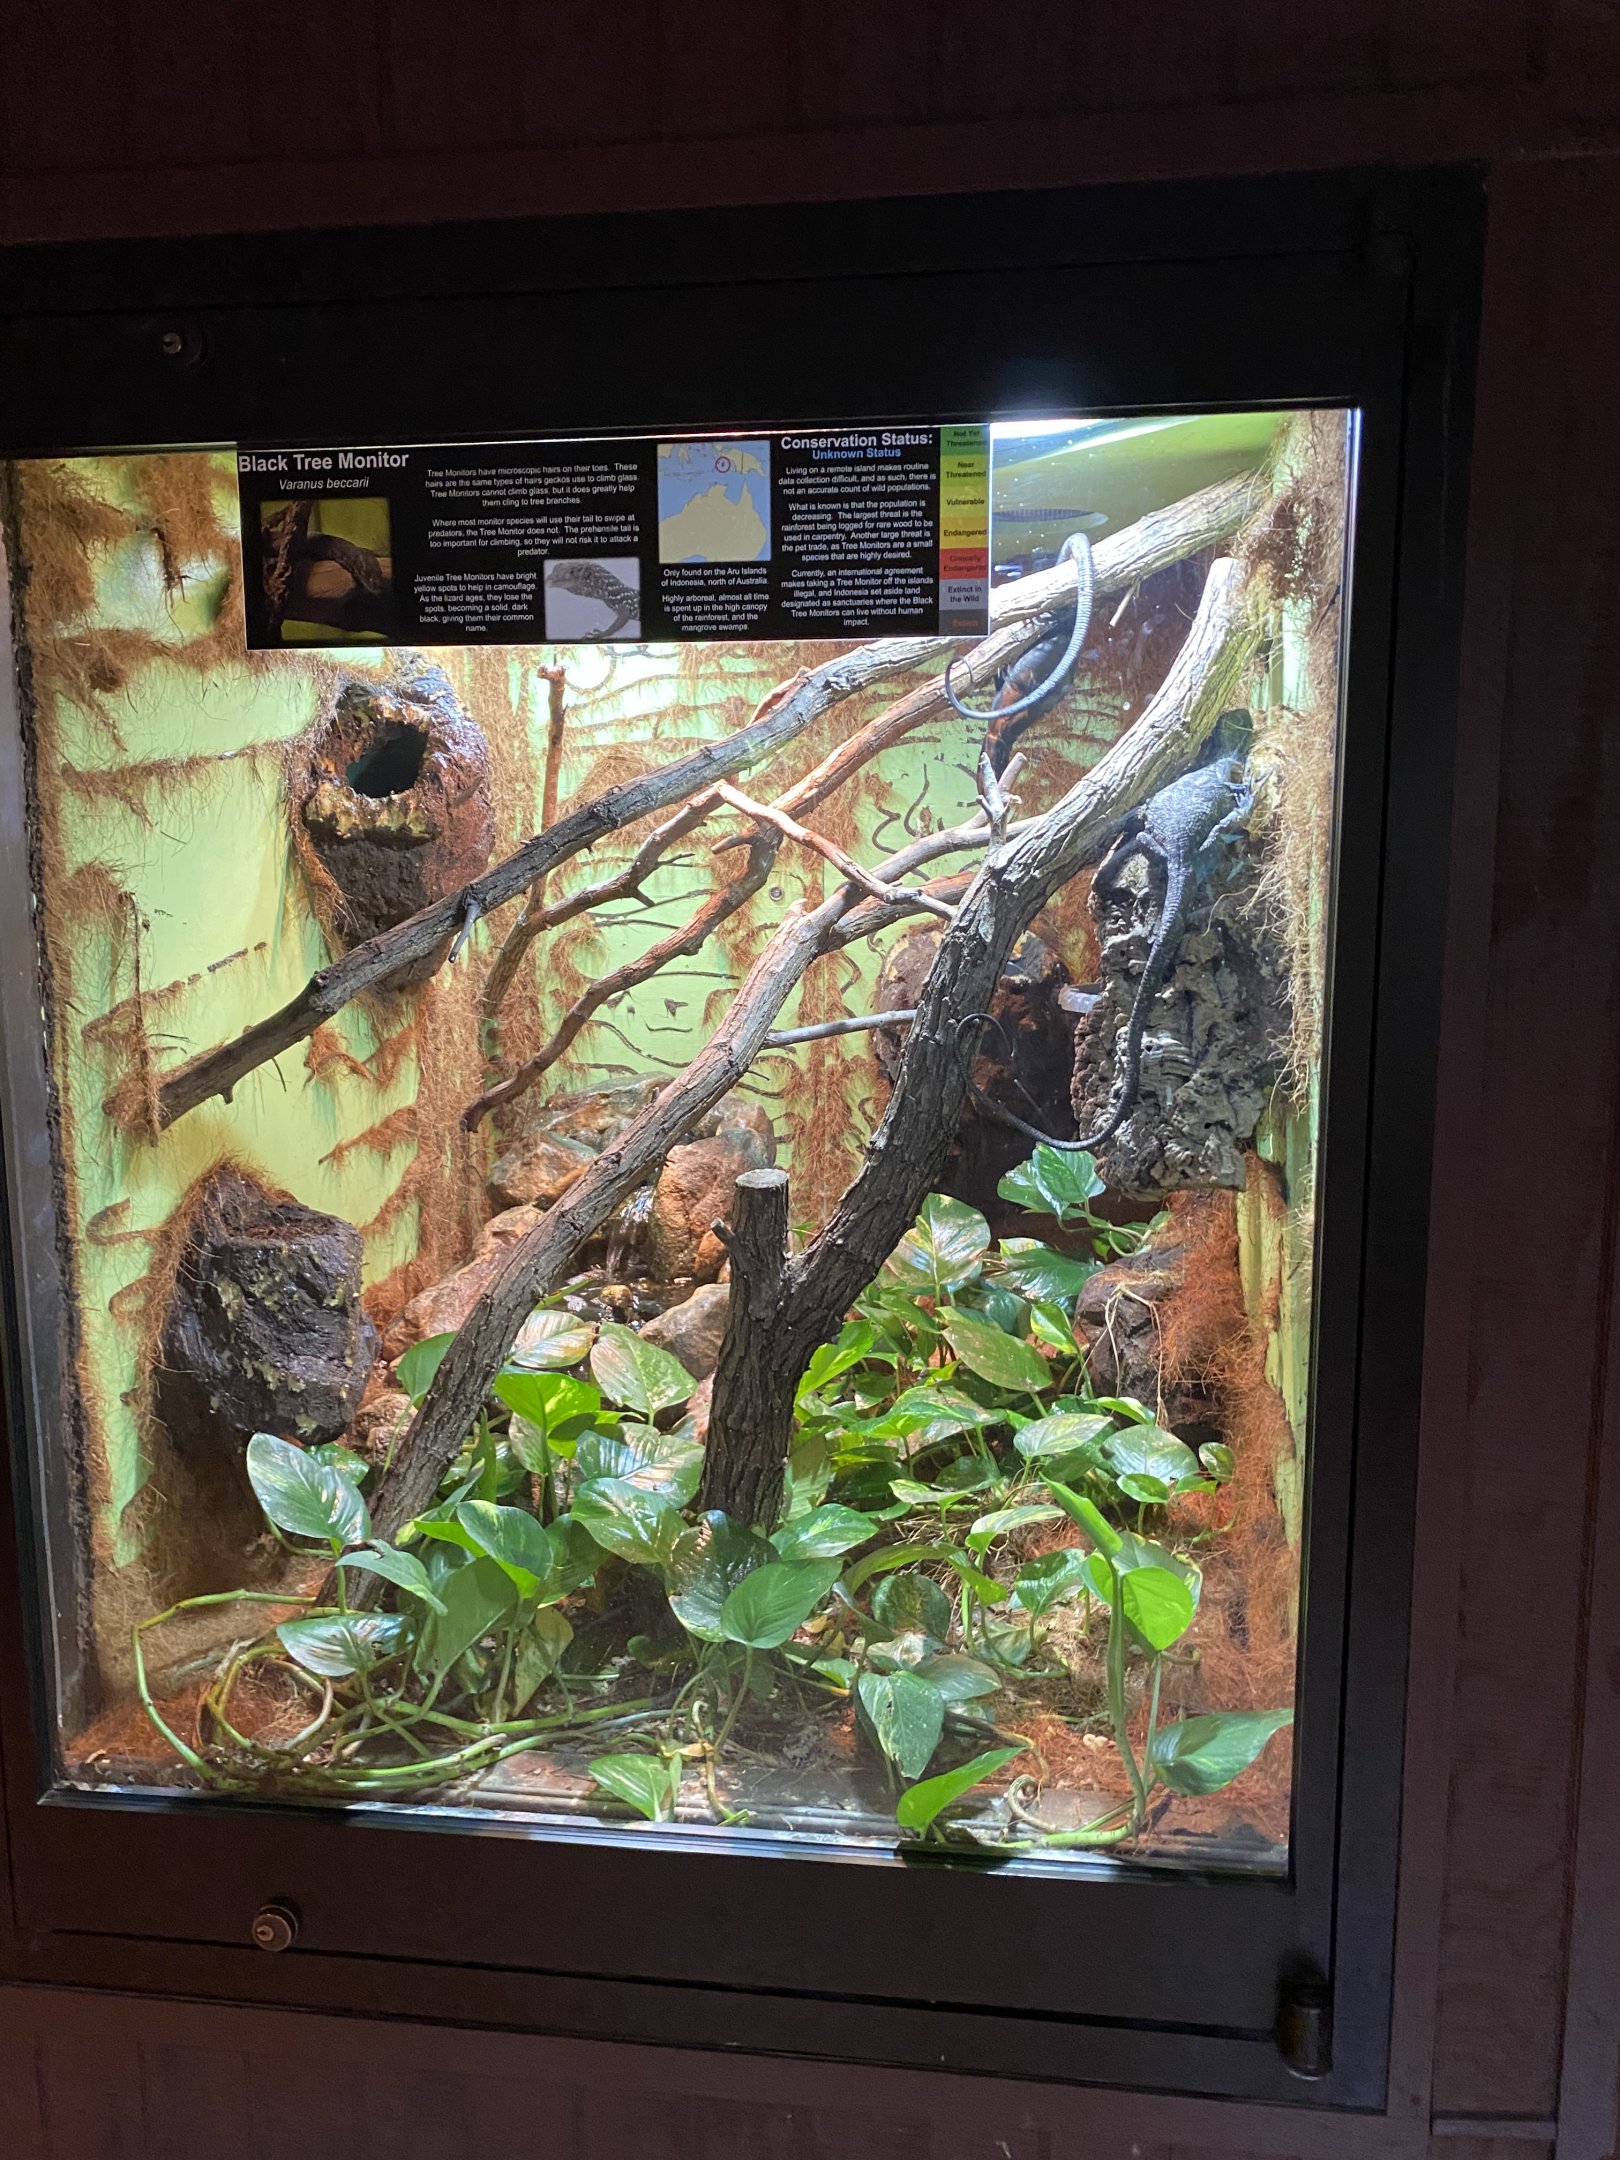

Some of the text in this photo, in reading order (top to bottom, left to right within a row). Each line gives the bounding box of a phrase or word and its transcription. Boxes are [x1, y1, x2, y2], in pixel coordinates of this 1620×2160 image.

[781, 432, 932, 449] Conservation Status:
[812, 447, 902, 460] Unknown Status
[238, 452, 409, 472] Black Tree Monitor
[428, 469, 444, 477] Tree
[498, 467, 541, 478] microscopic
[614, 462, 638, 471] These
[786, 467, 808, 477] Living
[854, 464, 876, 472] island
[903, 462, 929, 470] routine
[279, 476, 369, 490] Varanus beccarii
[807, 486, 839, 494] accurate
[862, 484, 870, 492] of
[866, 500, 878, 508] the
[879, 500, 918, 510] population
[506, 518, 534, 526] species
[536, 516, 548, 524] will
[604, 515, 626, 525] swipe
[853, 511, 878, 520] largest
[880, 510, 901, 518] threat
[781, 523, 815, 531] rainforest
[817, 523, 837, 532] being
[838, 521, 863, 531] logged
[865, 521, 875, 529] for
[893, 520, 912, 528] wood
[850, 530, 879, 539] Another
[881, 531, 899, 540] large
[901, 530, 922, 538] threat
[943, 528, 987, 538] Endangered
[802, 553, 829, 562] species
[831, 552, 845, 560] that
[860, 551, 882, 561] highly
[414, 574, 444, 582] Juvenile
[516, 572, 537, 582] bright
[663, 568, 680, 578] Only
[741, 567, 767, 575] Islands
[884, 567, 923, 577] agreement
[727, 577, 735, 585] of
[806, 579, 829, 588] taking
[836, 578, 853, 586] Tree
[883, 577, 893, 585] off
[818, 588, 832, 597] and
[883, 587, 903, 595] aside
[904, 586, 921, 594] land
[662, 594, 684, 604] Highly
[781, 598, 820, 609] designated
[913, 596, 933, 604] Black
[672, 603, 691, 613] spent
[692, 605, 702, 613] up
[724, 603, 740, 612] high
[742, 604, 768, 612] canopy
[791, 608, 808, 617] Tree
[681, 625, 717, 633] mangrove
